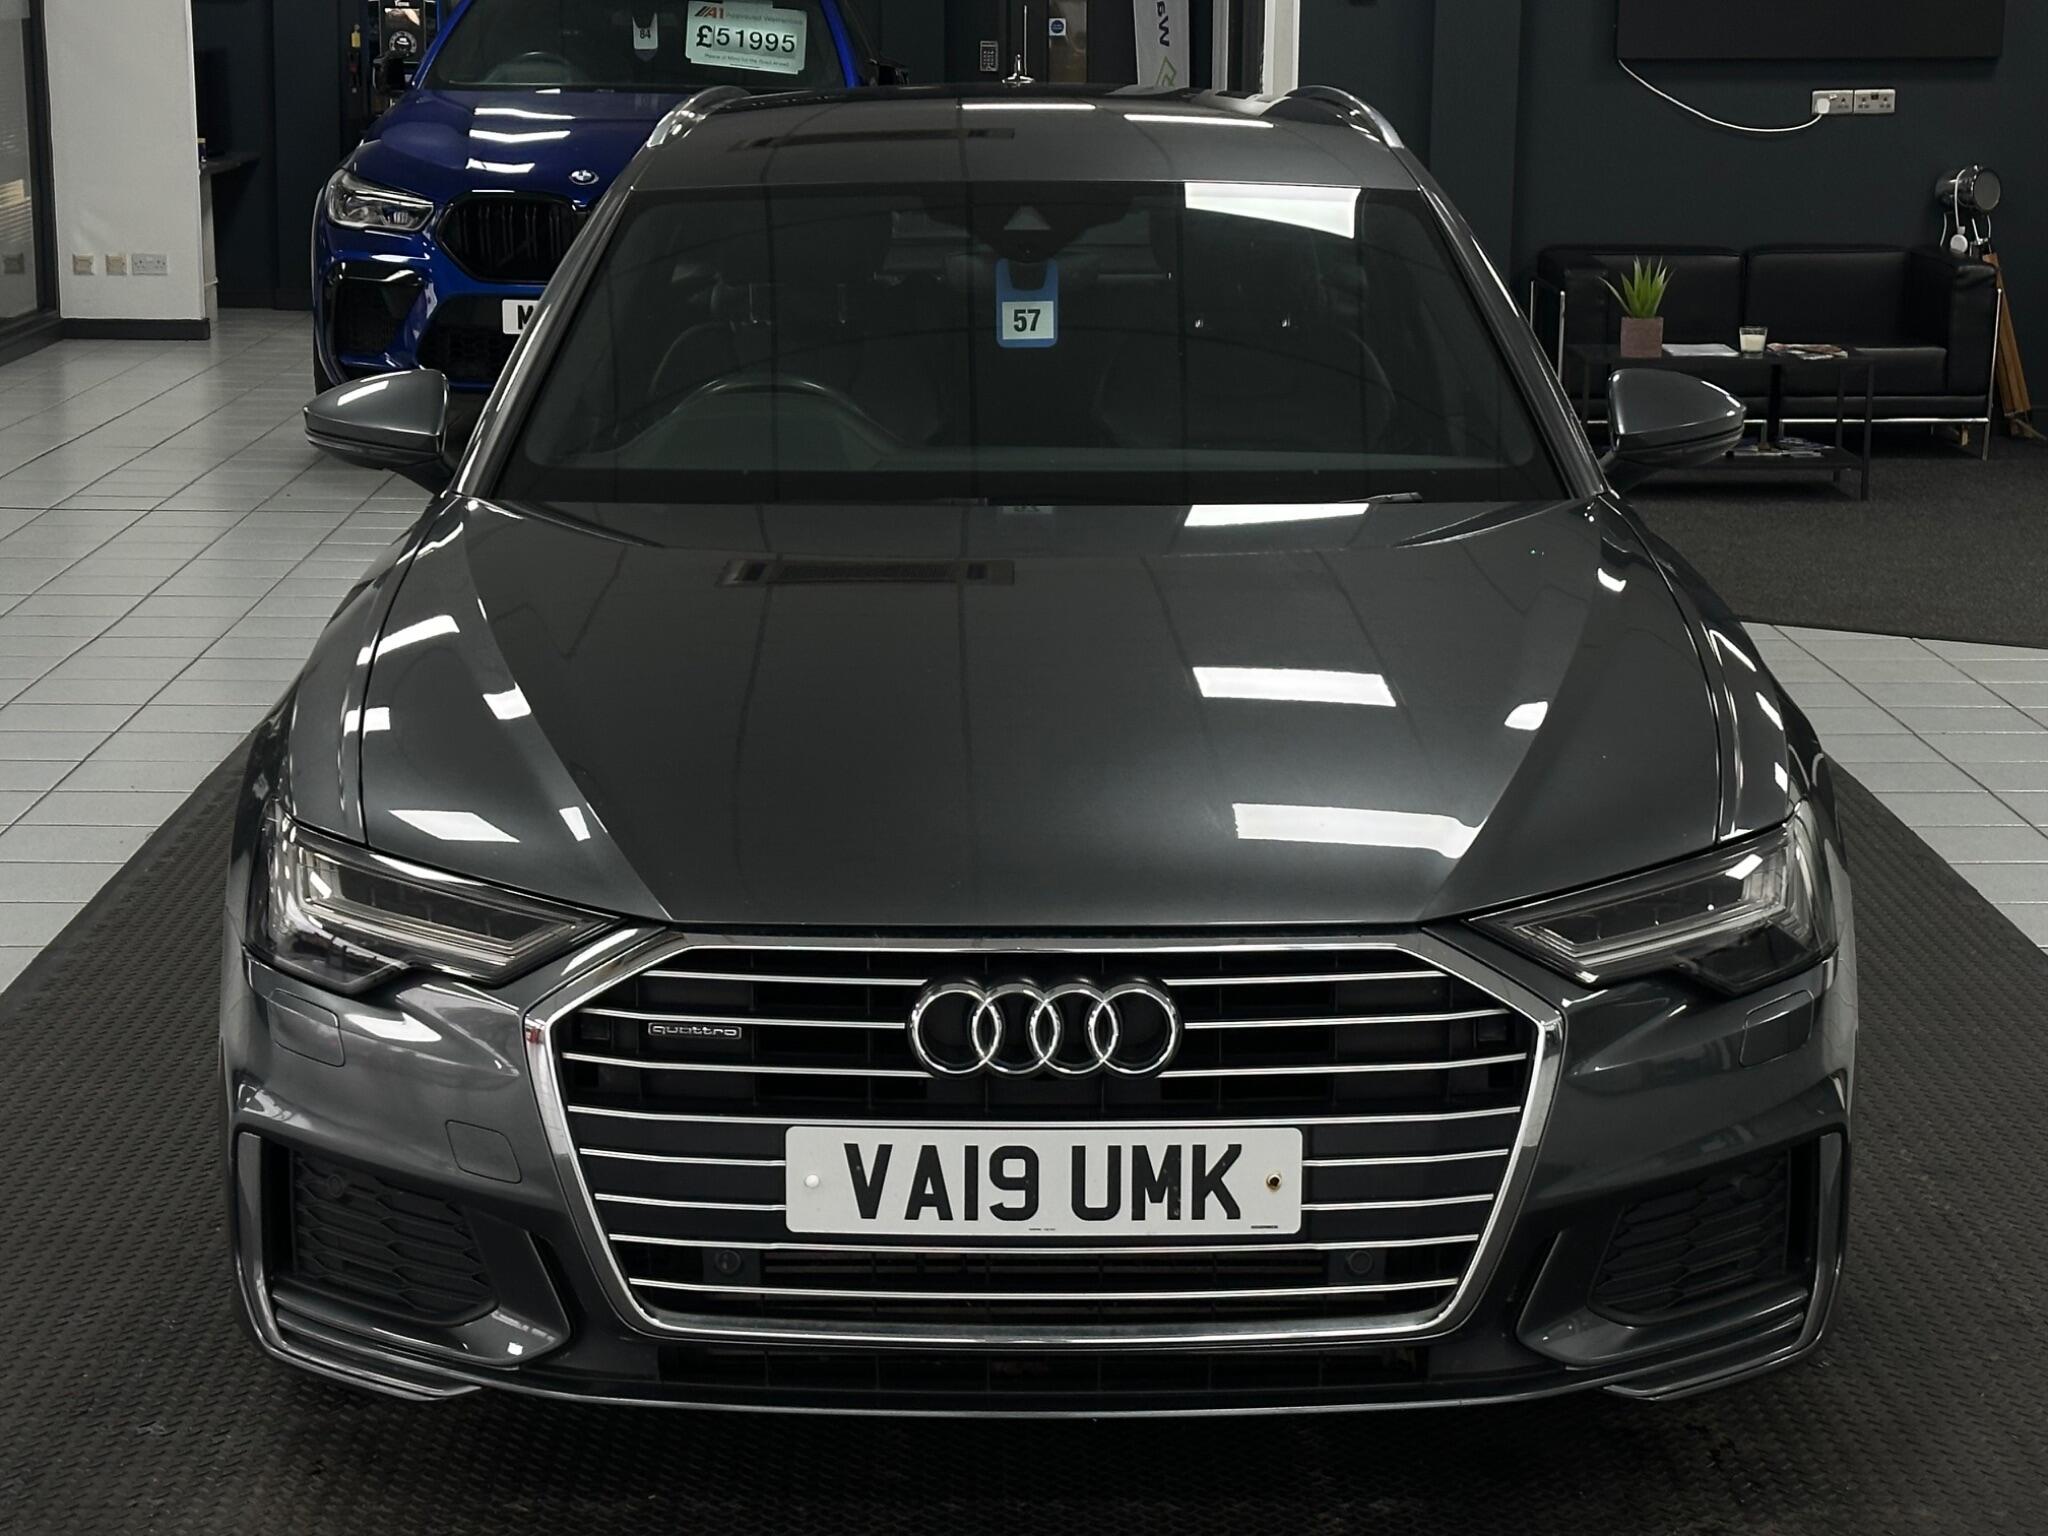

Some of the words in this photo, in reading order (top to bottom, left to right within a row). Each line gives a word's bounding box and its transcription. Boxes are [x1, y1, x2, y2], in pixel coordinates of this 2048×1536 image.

[696, 25, 796, 53] £51995
[1013, 308, 1041, 332] 57
[652, 1025, 738, 1036] quattro
[843, 1143, 1039, 1221] VA19
[1071, 1143, 1242, 1221] UMK
